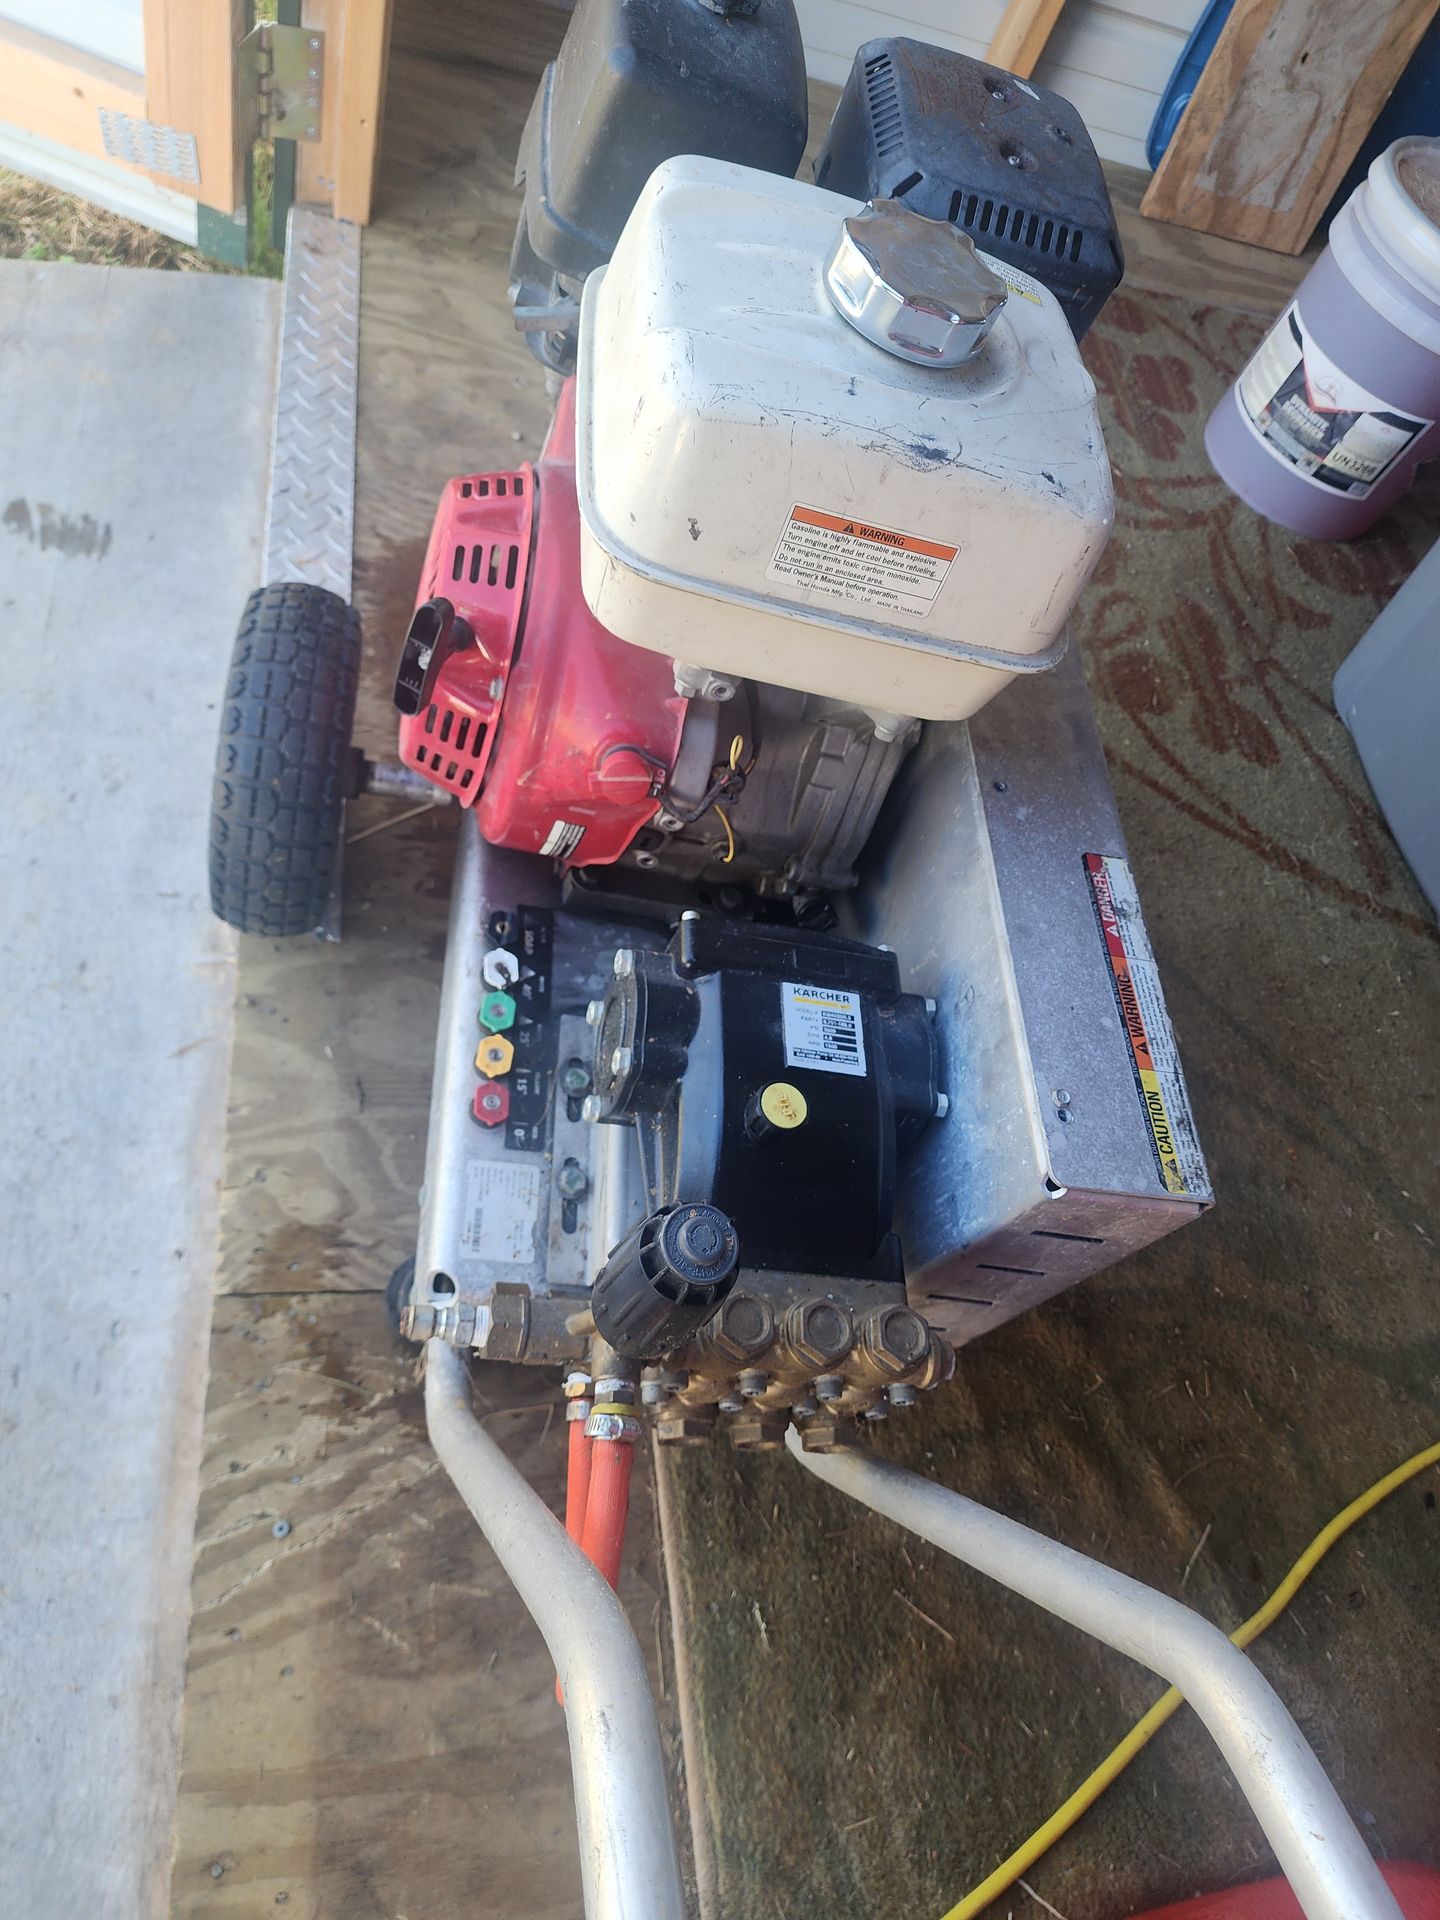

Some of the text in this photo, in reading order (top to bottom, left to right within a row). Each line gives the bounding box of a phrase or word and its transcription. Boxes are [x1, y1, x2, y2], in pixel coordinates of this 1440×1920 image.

[787, 531, 937, 577] Turn engine off and let cool before refueling.
[791, 522, 821, 536] Gasoline
[830, 532, 852, 545] highly
[852, 539, 890, 554] flammable
[891, 550, 905, 558] and
[905, 554, 938, 567] explosive.
[860, 527, 905, 546] WARNING
[773, 563, 899, 600] Read Owner's Manual before operation.
[778, 552, 884, 586] Do not run in an enclosed area.
[783, 543, 920, 585] The engine emits toxic carbon monoxide.
[810, 583, 830, 593] Honda
[831, 588, 844, 597] Mfg.
[877, 600, 892, 608] MADE
[900, 606, 924, 616] THAILAND
[1092, 871, 1116, 922] DANGER
[1118, 974, 1143, 1038] WARNING
[1148, 1090, 1174, 1155] CAUTION
